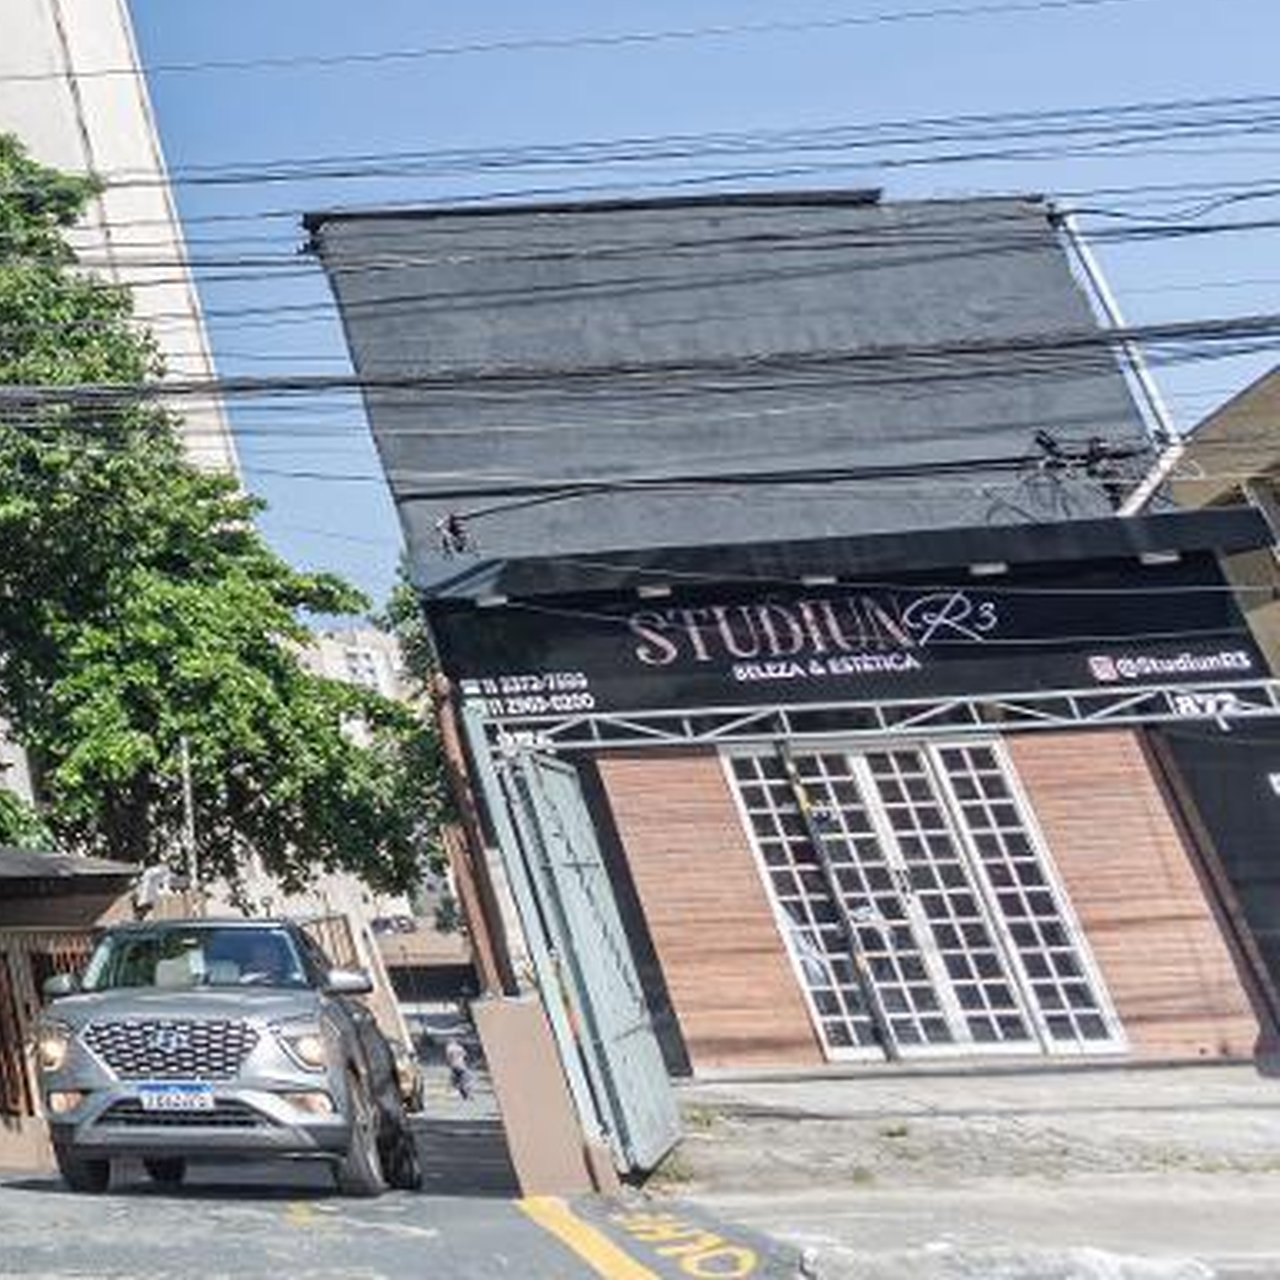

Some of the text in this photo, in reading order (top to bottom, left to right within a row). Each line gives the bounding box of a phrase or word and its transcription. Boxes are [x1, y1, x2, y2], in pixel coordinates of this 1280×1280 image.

[629, 595, 916, 665] STUDIUN
[732, 661, 806, 681] BELEZA
[808, 659, 826, 675] &
